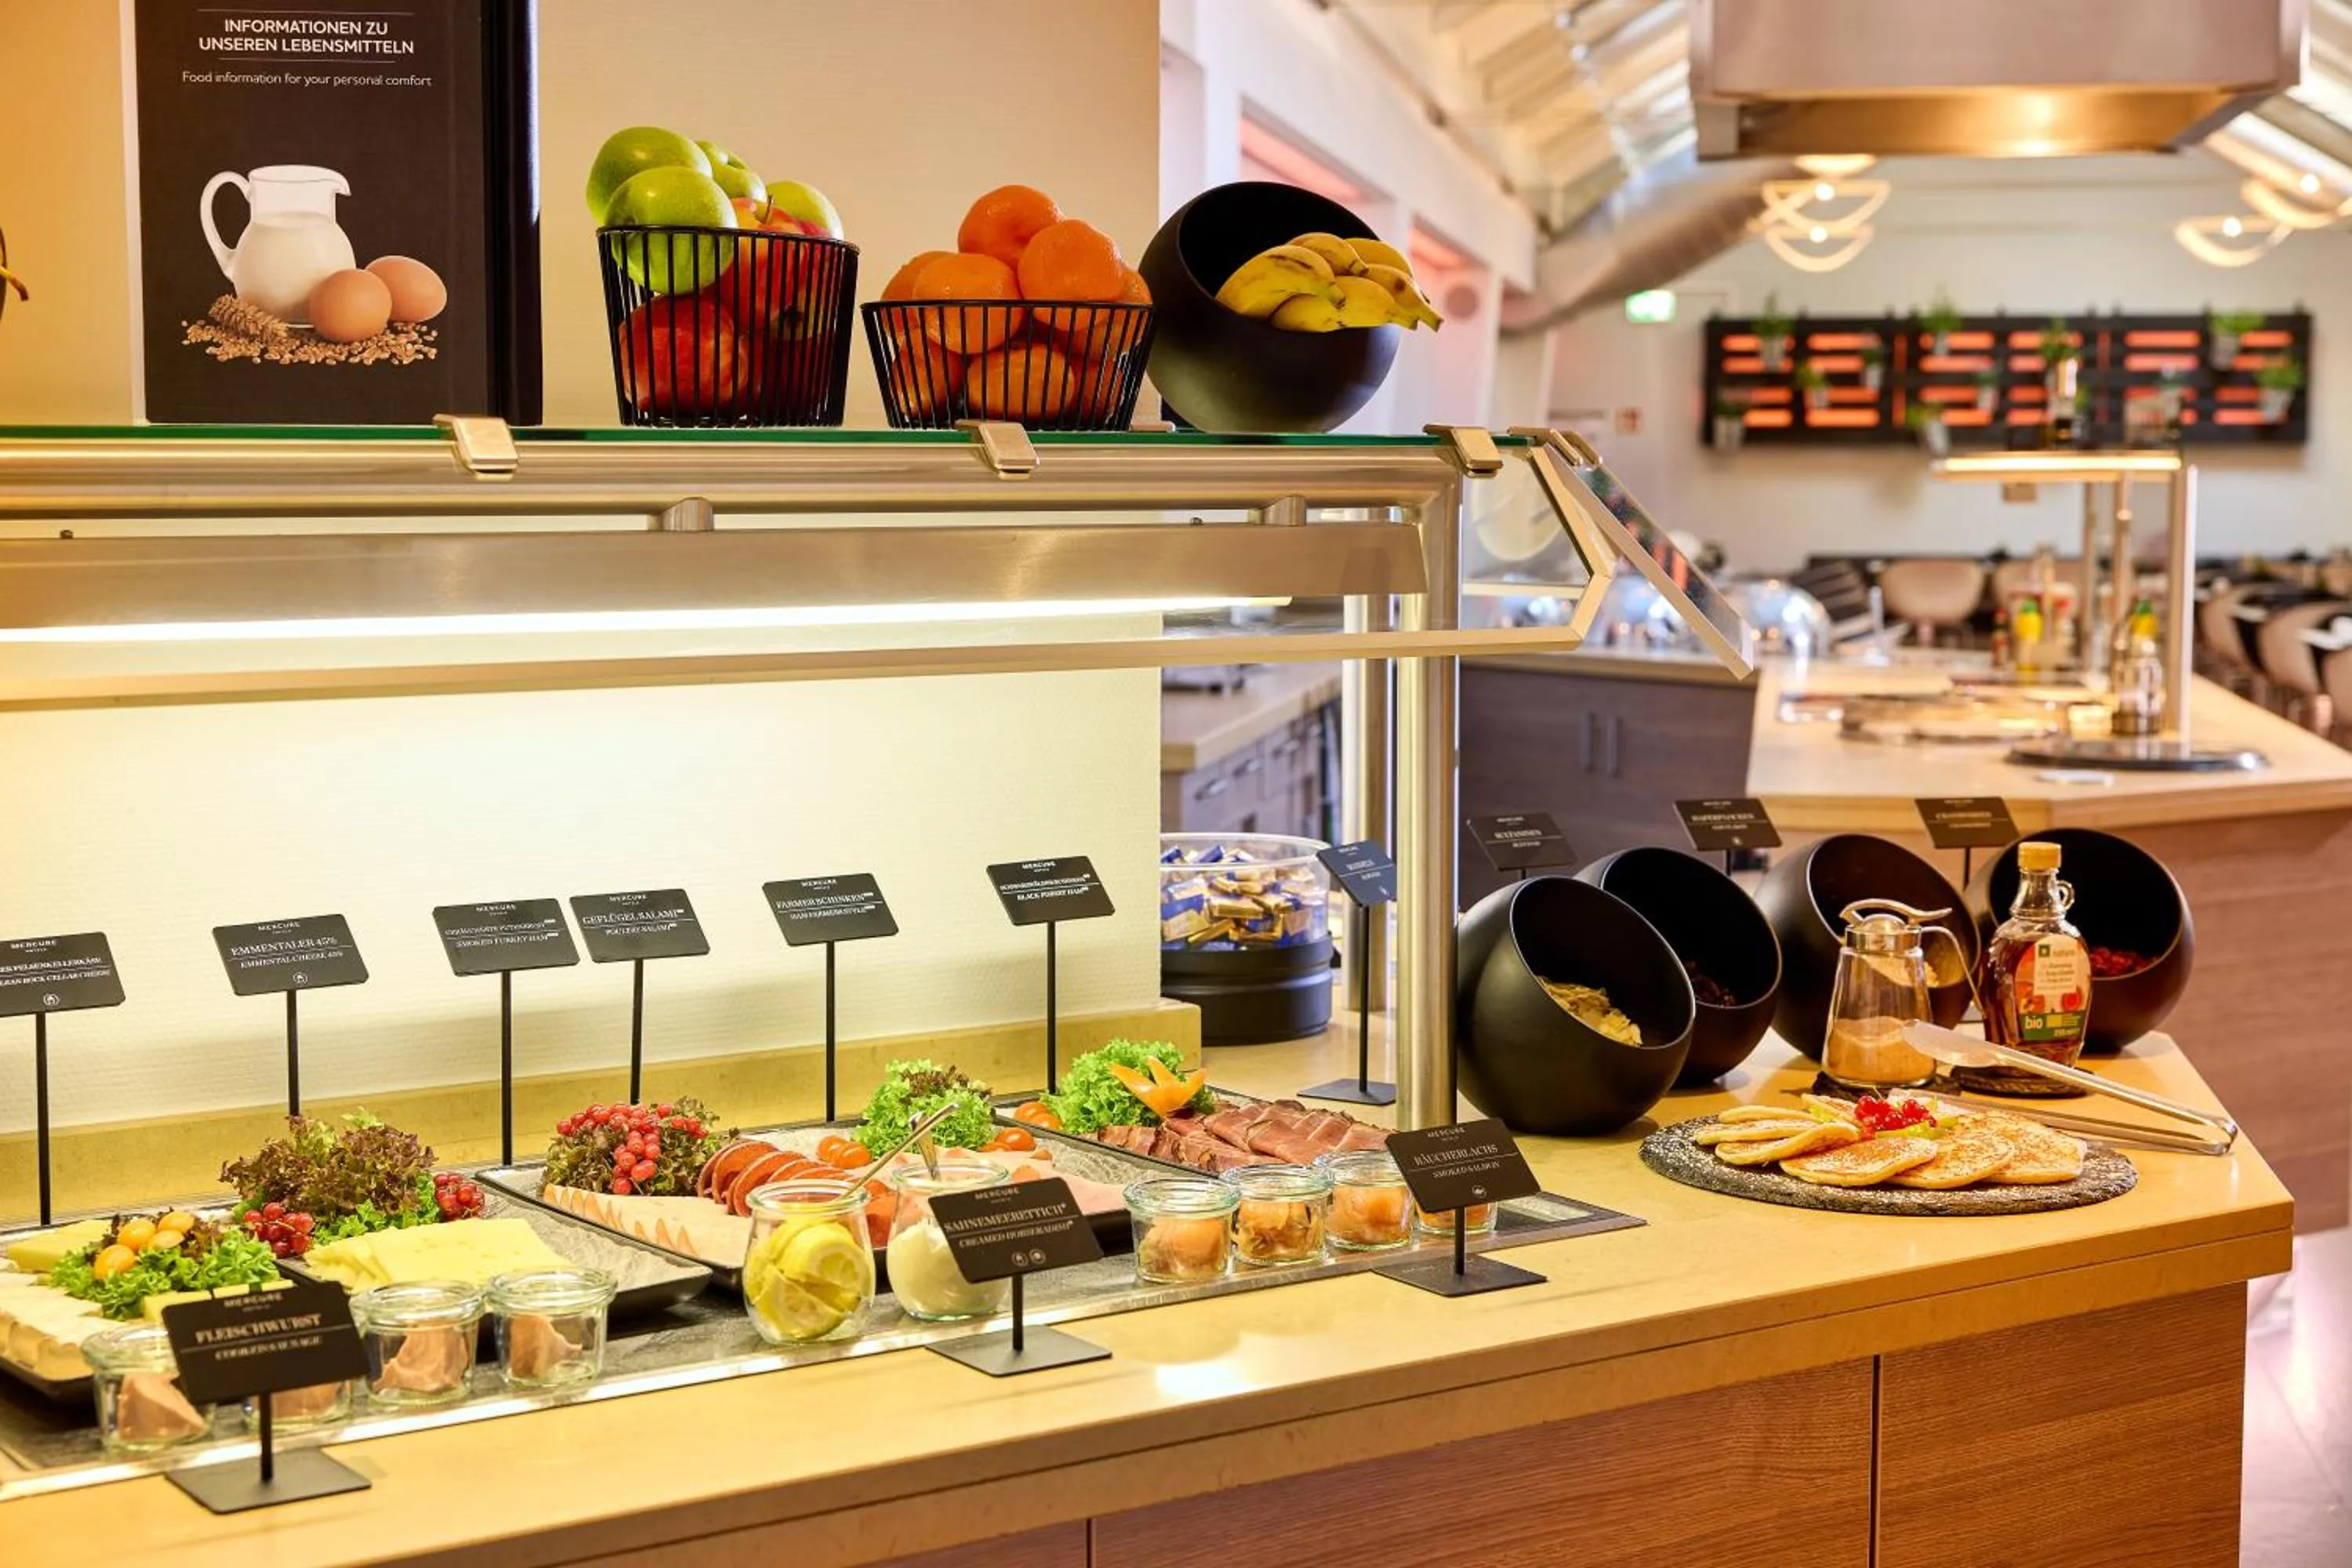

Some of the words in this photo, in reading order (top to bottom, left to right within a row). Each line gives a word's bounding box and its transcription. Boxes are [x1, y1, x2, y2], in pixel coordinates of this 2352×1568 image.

[224, 19, 362, 34] INFORMATIONEN
[365, 21, 389, 35] ZU
[198, 37, 278, 52] UNSEREN
[281, 38, 415, 54] LEBENSMITTELN
[182, 71, 212, 83] Food
[216, 71, 281, 85] information
[285, 73, 302, 85] for
[304, 75, 331, 88] your
[333, 74, 383, 88] personal
[386, 74, 433, 87] comfort
[258, 921, 301, 931] MERCURE
[230, 938, 313, 956] EMMENTALER
[240, 956, 291, 969] EMMENTAL
[2025, 1014, 2043, 1029] bio
[975, 1187, 1020, 1200] MERCURE
[959, 1231, 1005, 1248] CREAMED
[223, 1292, 283, 1308] MERCURE
[194, 1313, 322, 1344] FLEISCHWURST
